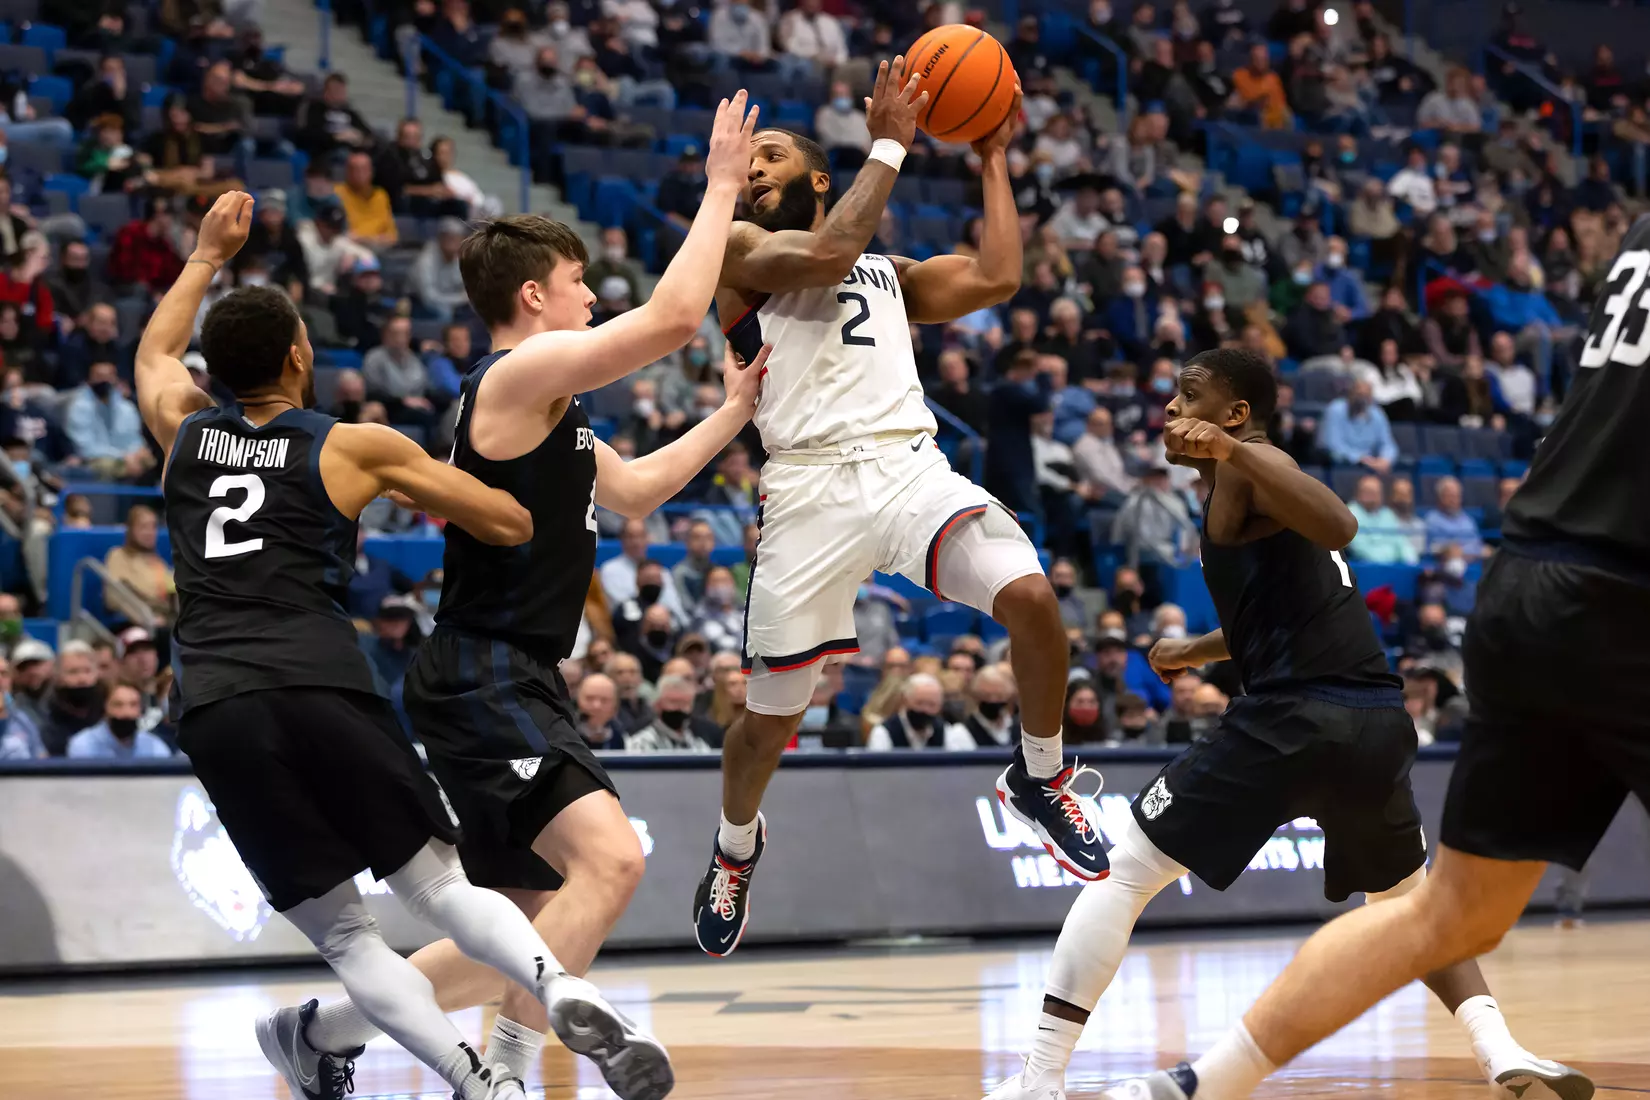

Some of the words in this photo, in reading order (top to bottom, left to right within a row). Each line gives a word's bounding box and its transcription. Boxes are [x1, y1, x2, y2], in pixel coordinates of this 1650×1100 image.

[921, 43, 949, 79] UCONN
[836, 291, 876, 347] 2
[197, 427, 290, 468] THOMPSON
[575, 427, 594, 450] BU
[204, 473, 266, 559] 2
